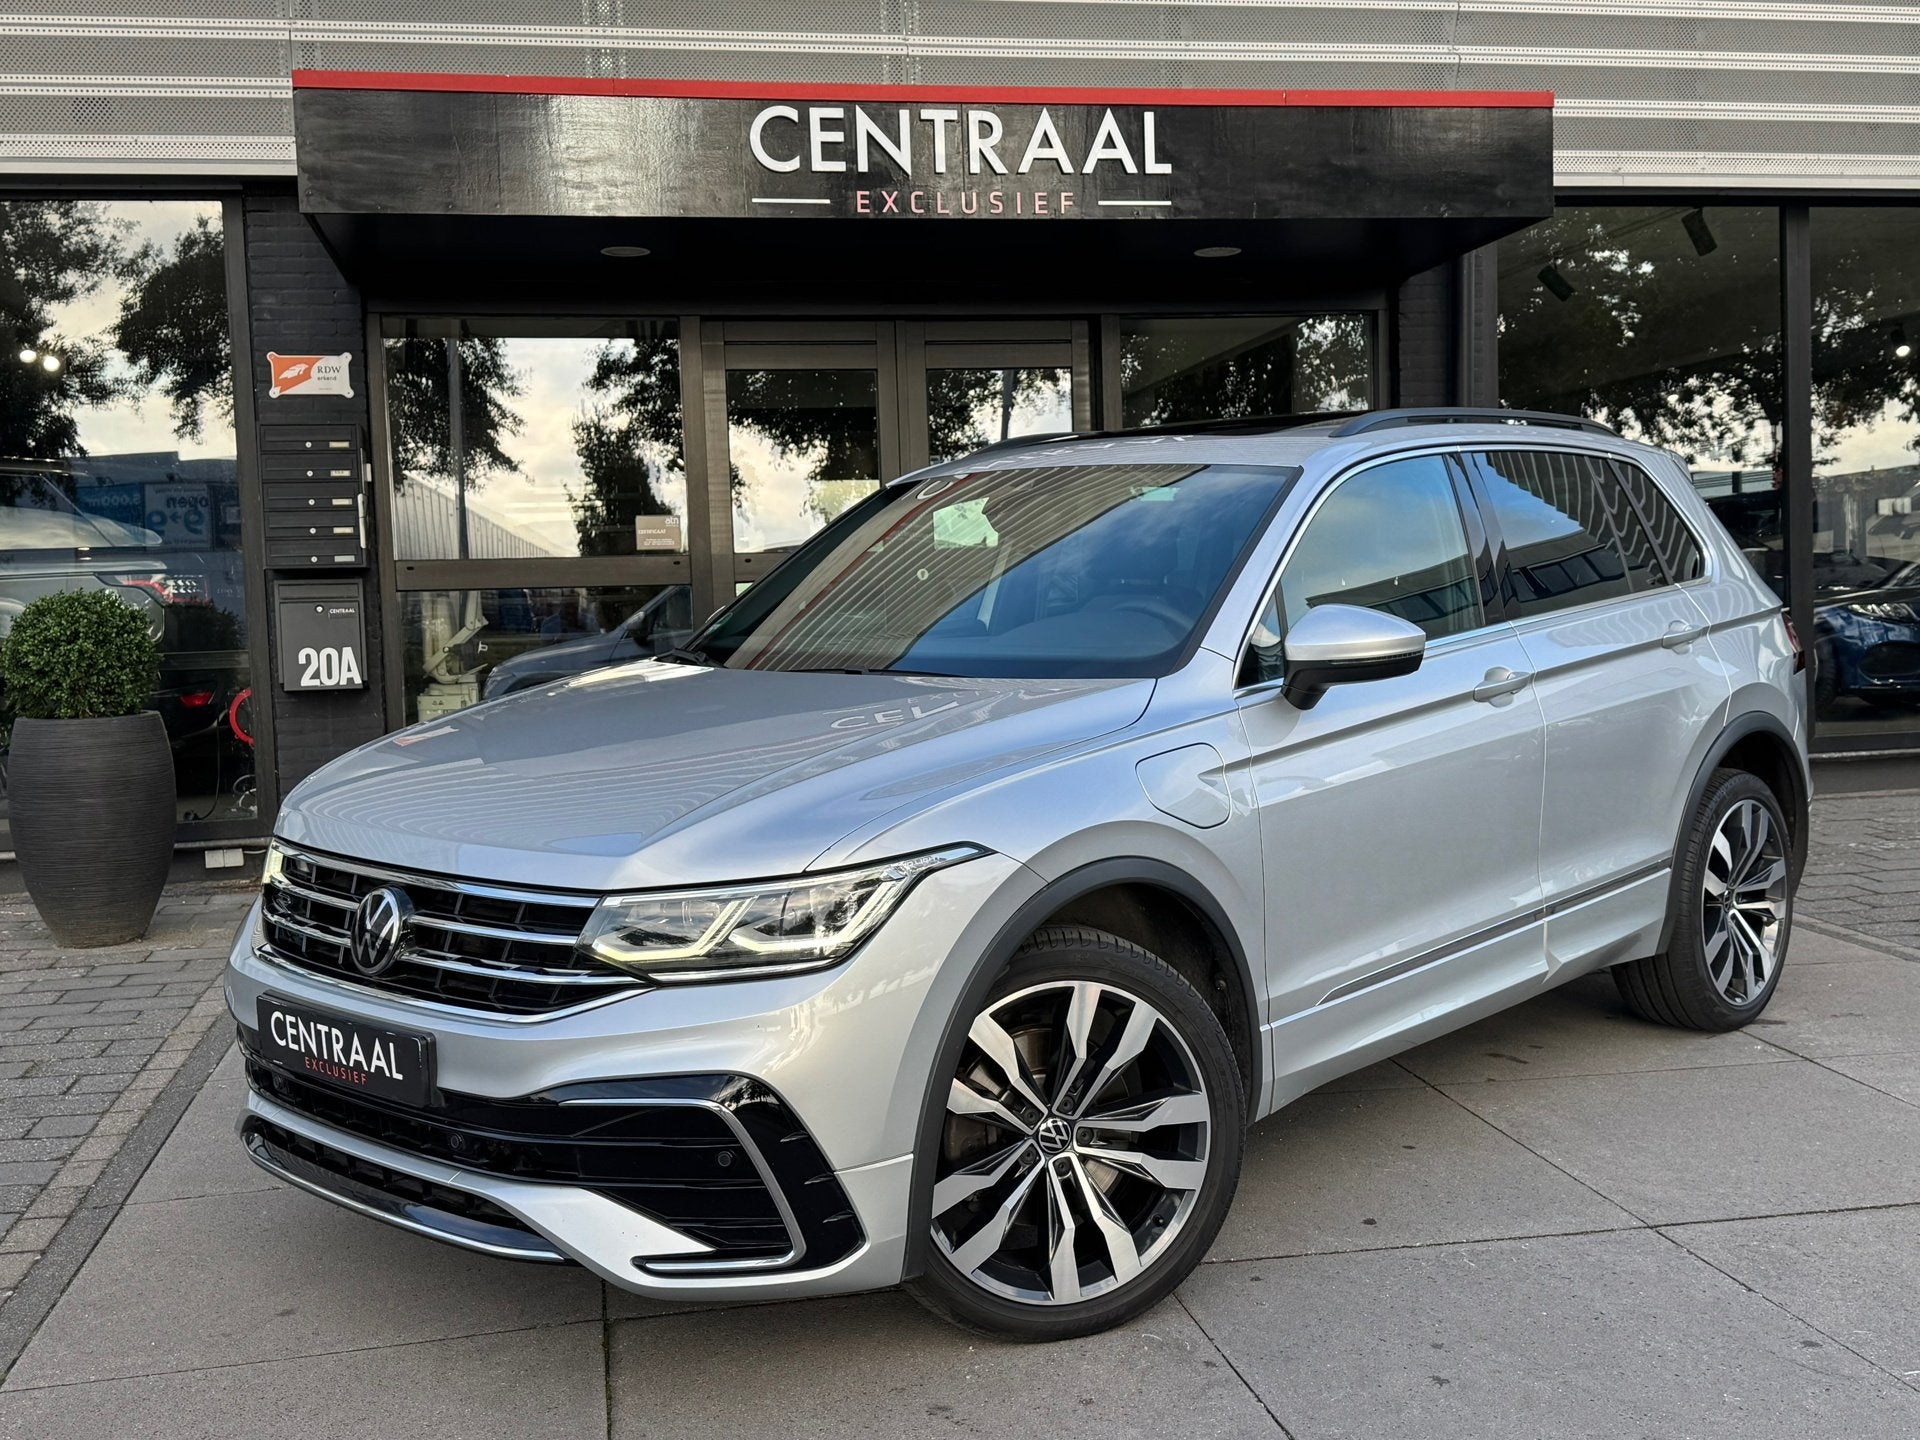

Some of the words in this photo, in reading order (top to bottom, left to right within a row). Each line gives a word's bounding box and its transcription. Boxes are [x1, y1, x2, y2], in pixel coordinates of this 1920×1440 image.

[750, 104, 1173, 177] CENTRAAL
[856, 190, 1074, 215] EXCLUSIEF
[317, 365, 341, 374] RDW
[298, 646, 362, 687] 20A
[270, 1010, 404, 1081] CENTRAAL
[304, 1056, 368, 1086] EXCLUSIEF
